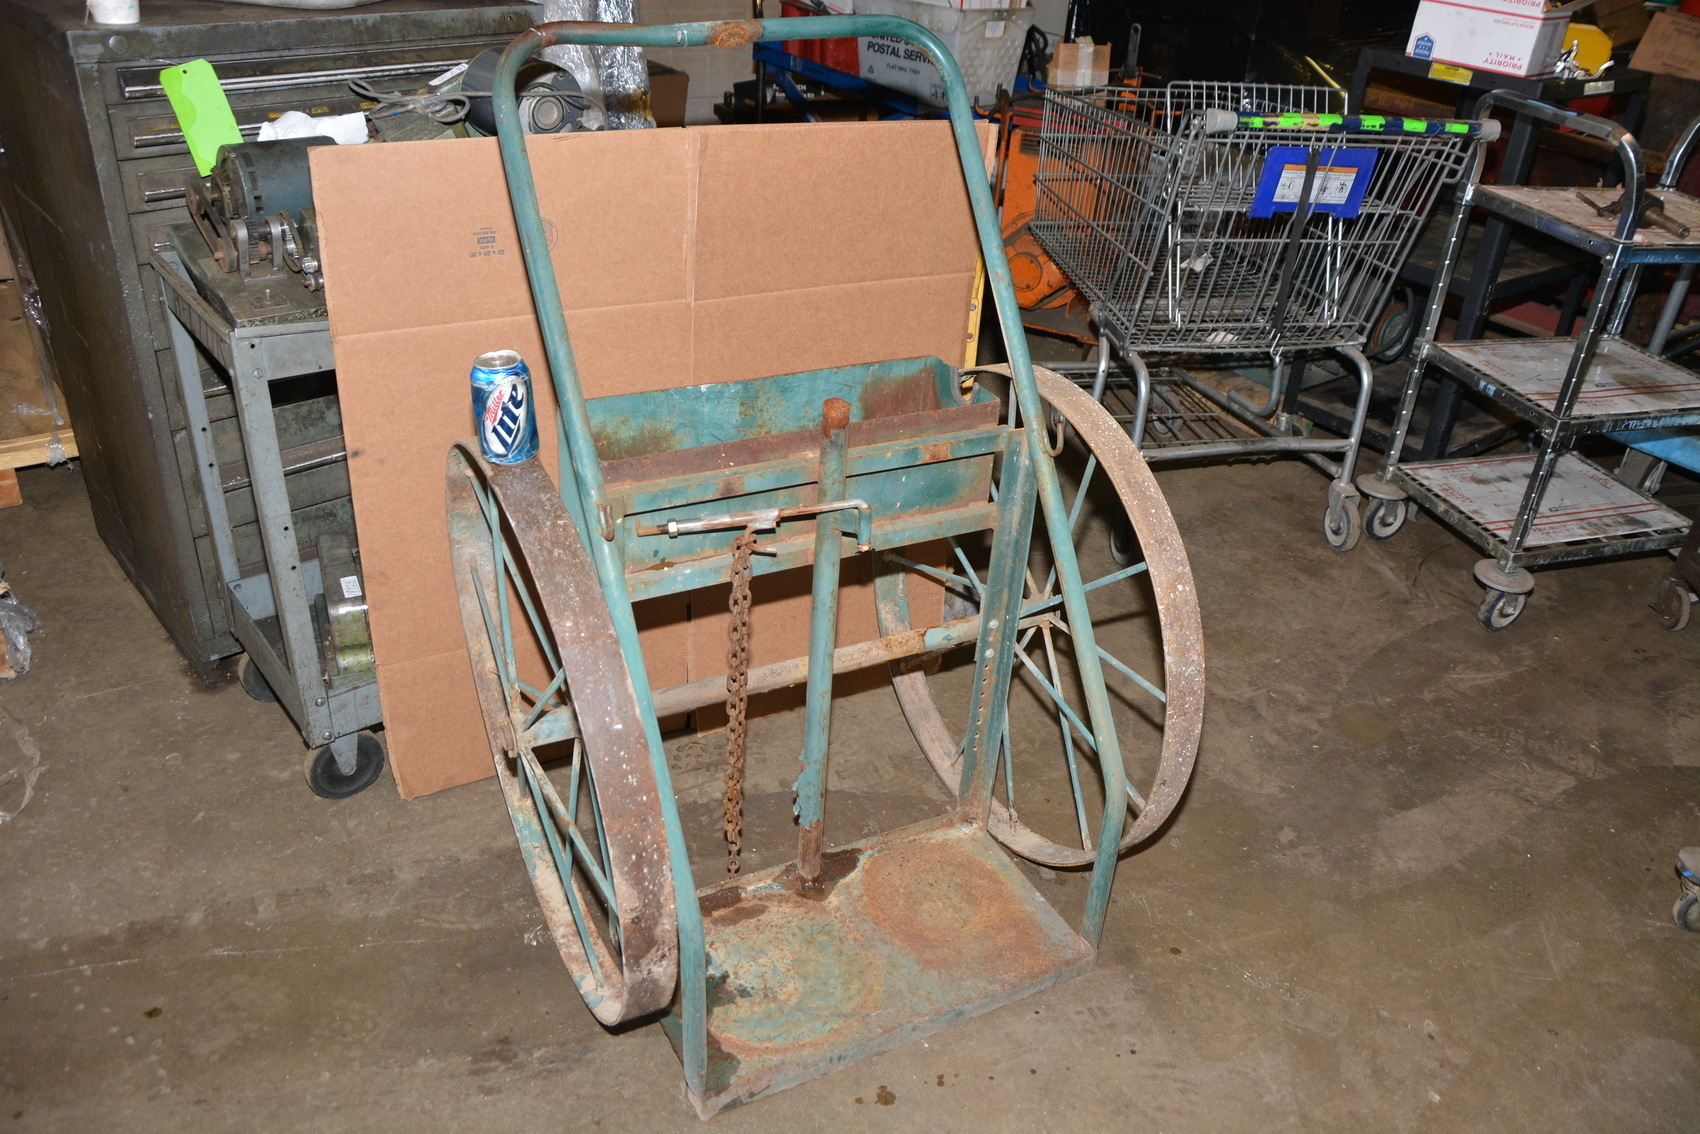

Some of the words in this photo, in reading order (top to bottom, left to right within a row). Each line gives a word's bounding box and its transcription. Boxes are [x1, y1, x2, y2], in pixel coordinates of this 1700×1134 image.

[867, 41, 901, 58] POSTAL
[903, 48, 935, 65] SERVI
[1495, 52, 1514, 60] MAIL
[886, 62, 897, 70] FLAT
[897, 64, 907, 72] MAIL
[908, 67, 921, 76] TRAY
[1482, 58, 1523, 70] PRIORITY
[478, 236, 495, 244] ULINE
[483, 389, 505, 426] Miller
[491, 383, 524, 456] Lite
